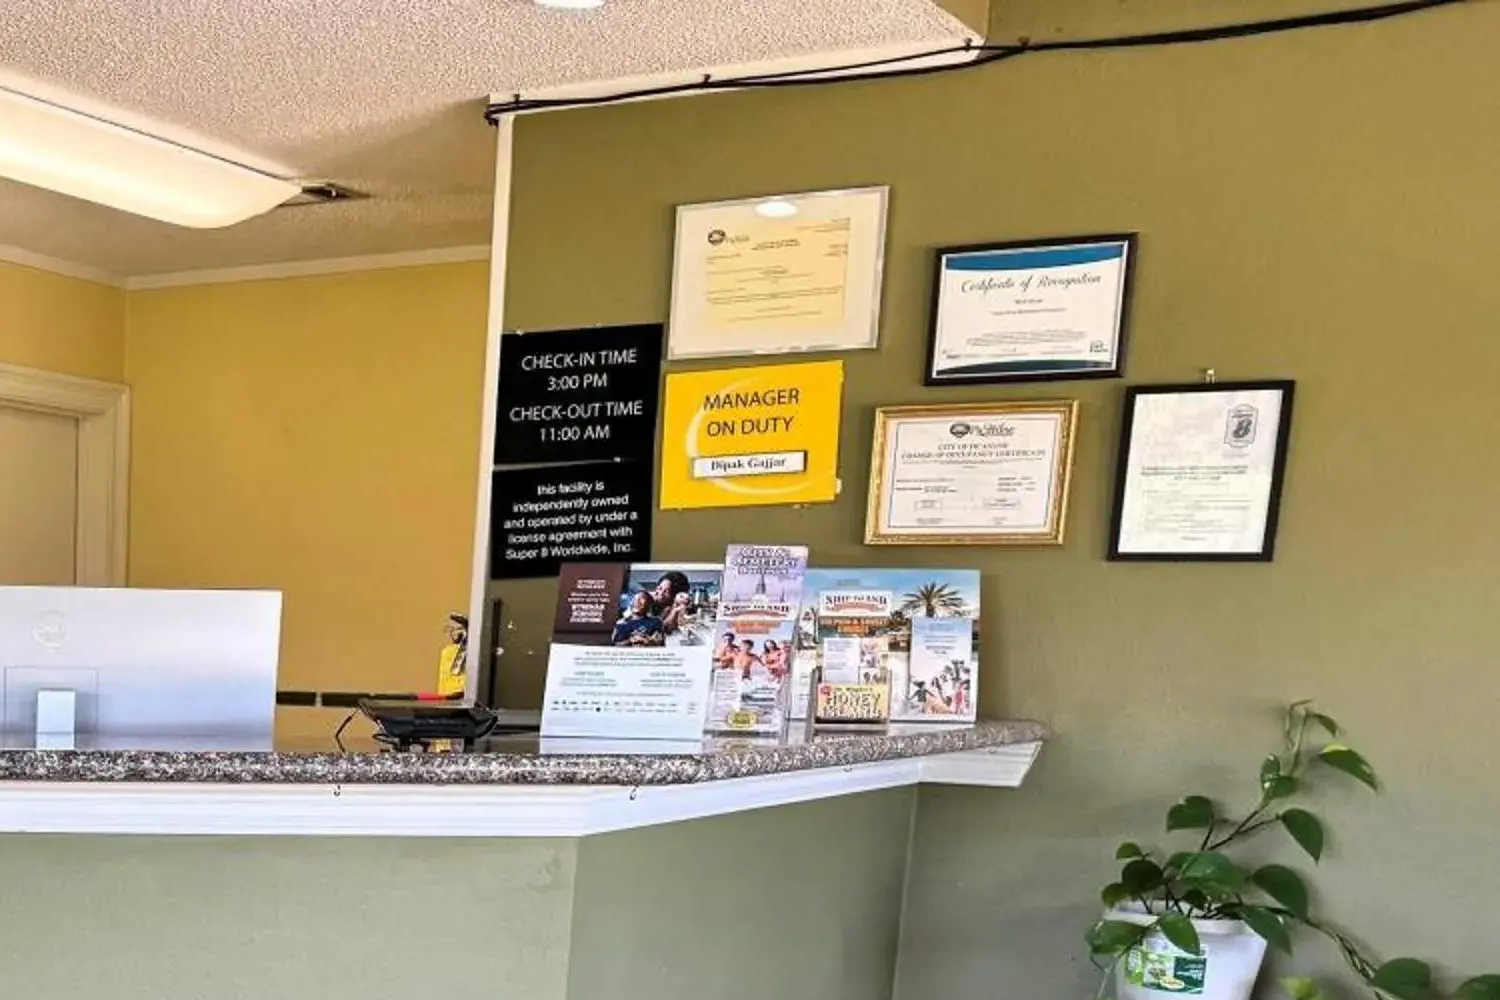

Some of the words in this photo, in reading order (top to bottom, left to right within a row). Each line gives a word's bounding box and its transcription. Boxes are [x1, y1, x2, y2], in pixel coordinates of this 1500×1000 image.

[1019, 275, 1033, 293] of
[521, 352, 596, 371] CHECK-IN
[598, 347, 637, 365] TIME
[547, 375, 580, 391] 3:00
[583, 372, 608, 388] PM
[703, 388, 800, 411] MANAGER
[509, 402, 601, 421] CHECK-OUT
[604, 400, 643, 416] TIME
[540, 425, 580, 442] 11:00
[583, 424, 611, 440] AM
[707, 420, 735, 437] ON
[741, 416, 795, 435] DUTY
[711, 459, 745, 472] Dipak
[558, 481, 593, 494] facility
[595, 480, 605, 491] is
[513, 498, 589, 513] independently
[591, 493, 628, 507] owned
[503, 518, 525, 529] and
[527, 514, 577, 528] operated
[578, 514, 593, 526] by
[595, 510, 629, 523] under
[629, 511, 638, 521] a
[508, 533, 546, 544] license
[548, 528, 607, 543] agreement
[609, 525, 633, 537] with
[505, 548, 539, 560] Super
[541, 547, 548, 558] 8
[550, 544, 611, 557] Worldwide,
